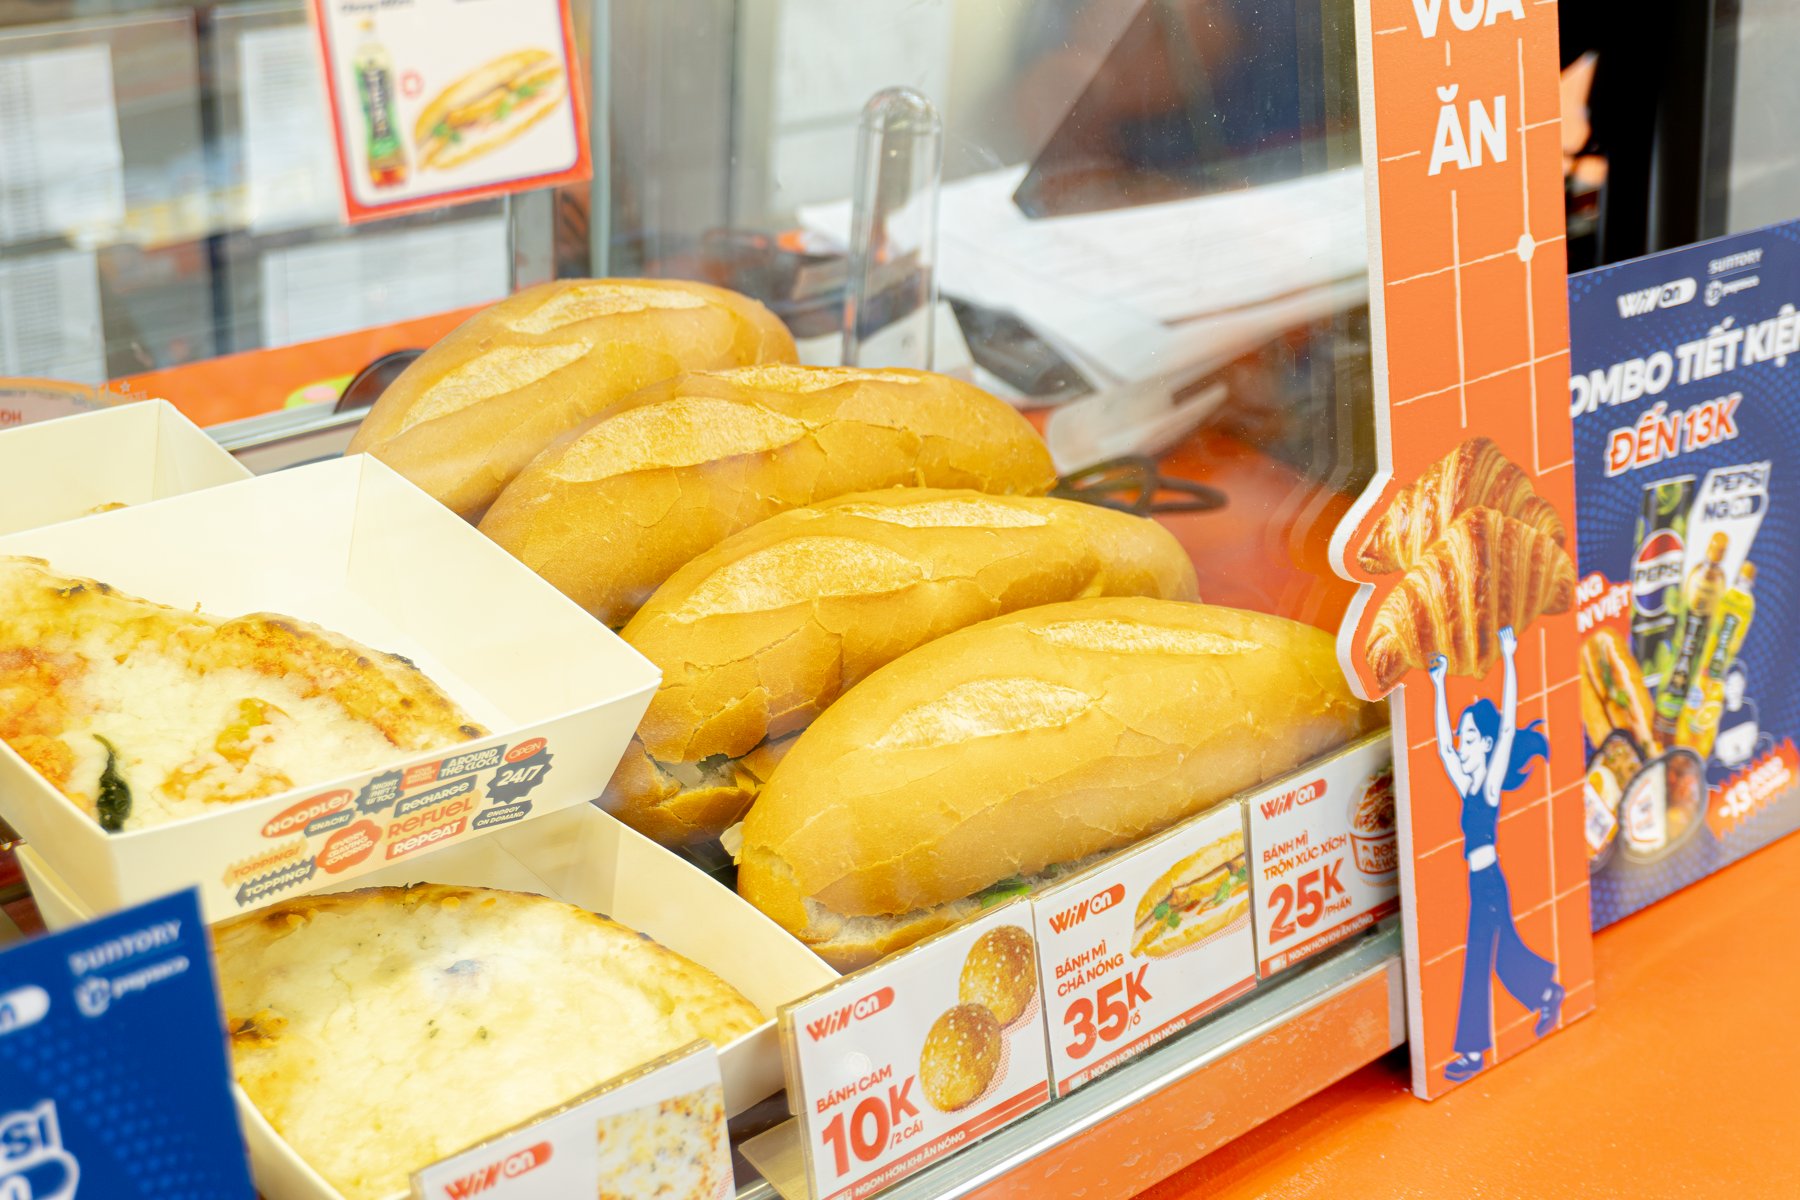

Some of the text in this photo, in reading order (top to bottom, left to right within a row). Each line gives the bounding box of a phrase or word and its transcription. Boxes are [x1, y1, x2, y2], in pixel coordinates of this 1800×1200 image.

[1428, 84, 1507, 176] ĂN
[1569, 303, 1800, 418] OMBO TIẾT KIỆ
[1605, 393, 1743, 477] ĐẾN 13K
[1577, 574, 1603, 605] NG
[447, 748, 498, 768] AROUND
[464, 755, 500, 771] CLOCK
[496, 764, 545, 787] 24/7
[477, 818, 491, 827] ON
[1263, 830, 1309, 863] BÁNH MÌ
[1263, 858, 1295, 881] TRỘN
[1295, 845, 1319, 868] XÚC
[1320, 833, 1348, 857] XÍCH
[1269, 858, 1345, 945] 25K
[1055, 939, 1108, 980] BÁNH MÌ
[1057, 953, 1125, 998] CHẢ NÓNG
[1064, 963, 1153, 1060] 35K
[816, 1064, 892, 1114] BÁNH CAM
[822, 1074, 920, 1178] 10K
[903, 1120, 923, 1139] CÁI
[854, 1173, 884, 1196] NGON
[907, 1154, 922, 1171] KHI
[936, 1130, 966, 1153] NÓNG
